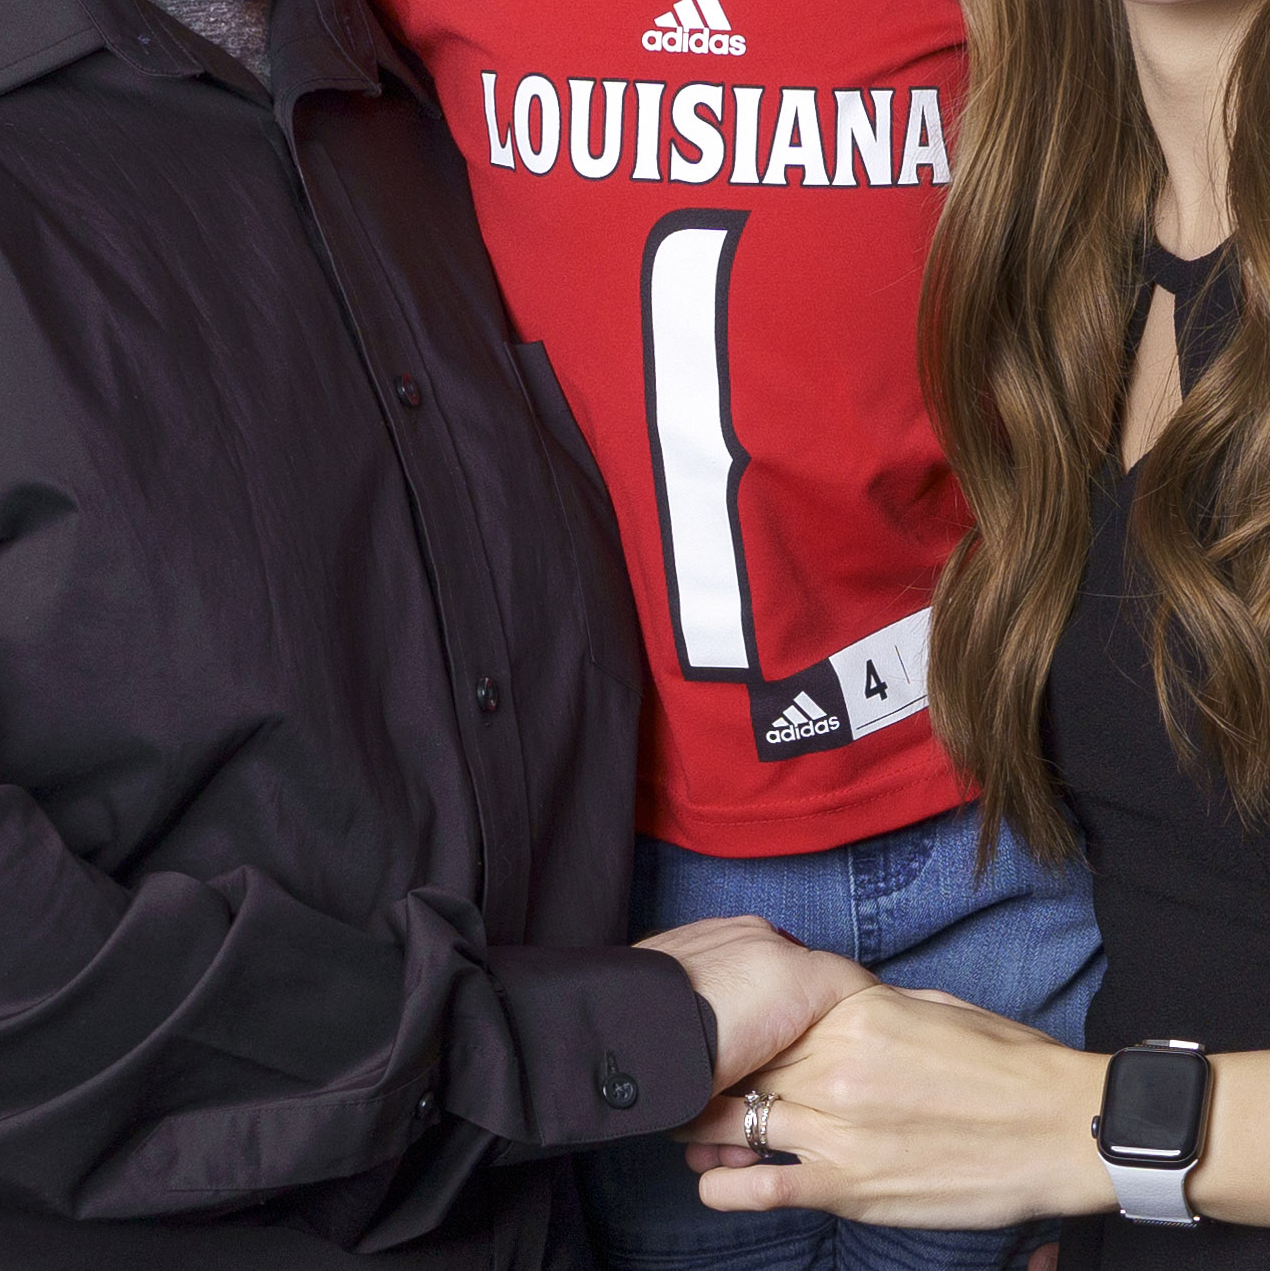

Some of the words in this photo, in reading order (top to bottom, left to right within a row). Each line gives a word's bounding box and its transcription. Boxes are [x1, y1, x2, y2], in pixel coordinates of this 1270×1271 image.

[641, 27, 747, 56] adidas
[480, 70, 953, 188] LOUISIANA
[865, 659, 888, 700] 4
[766, 716, 840, 743] adidas
